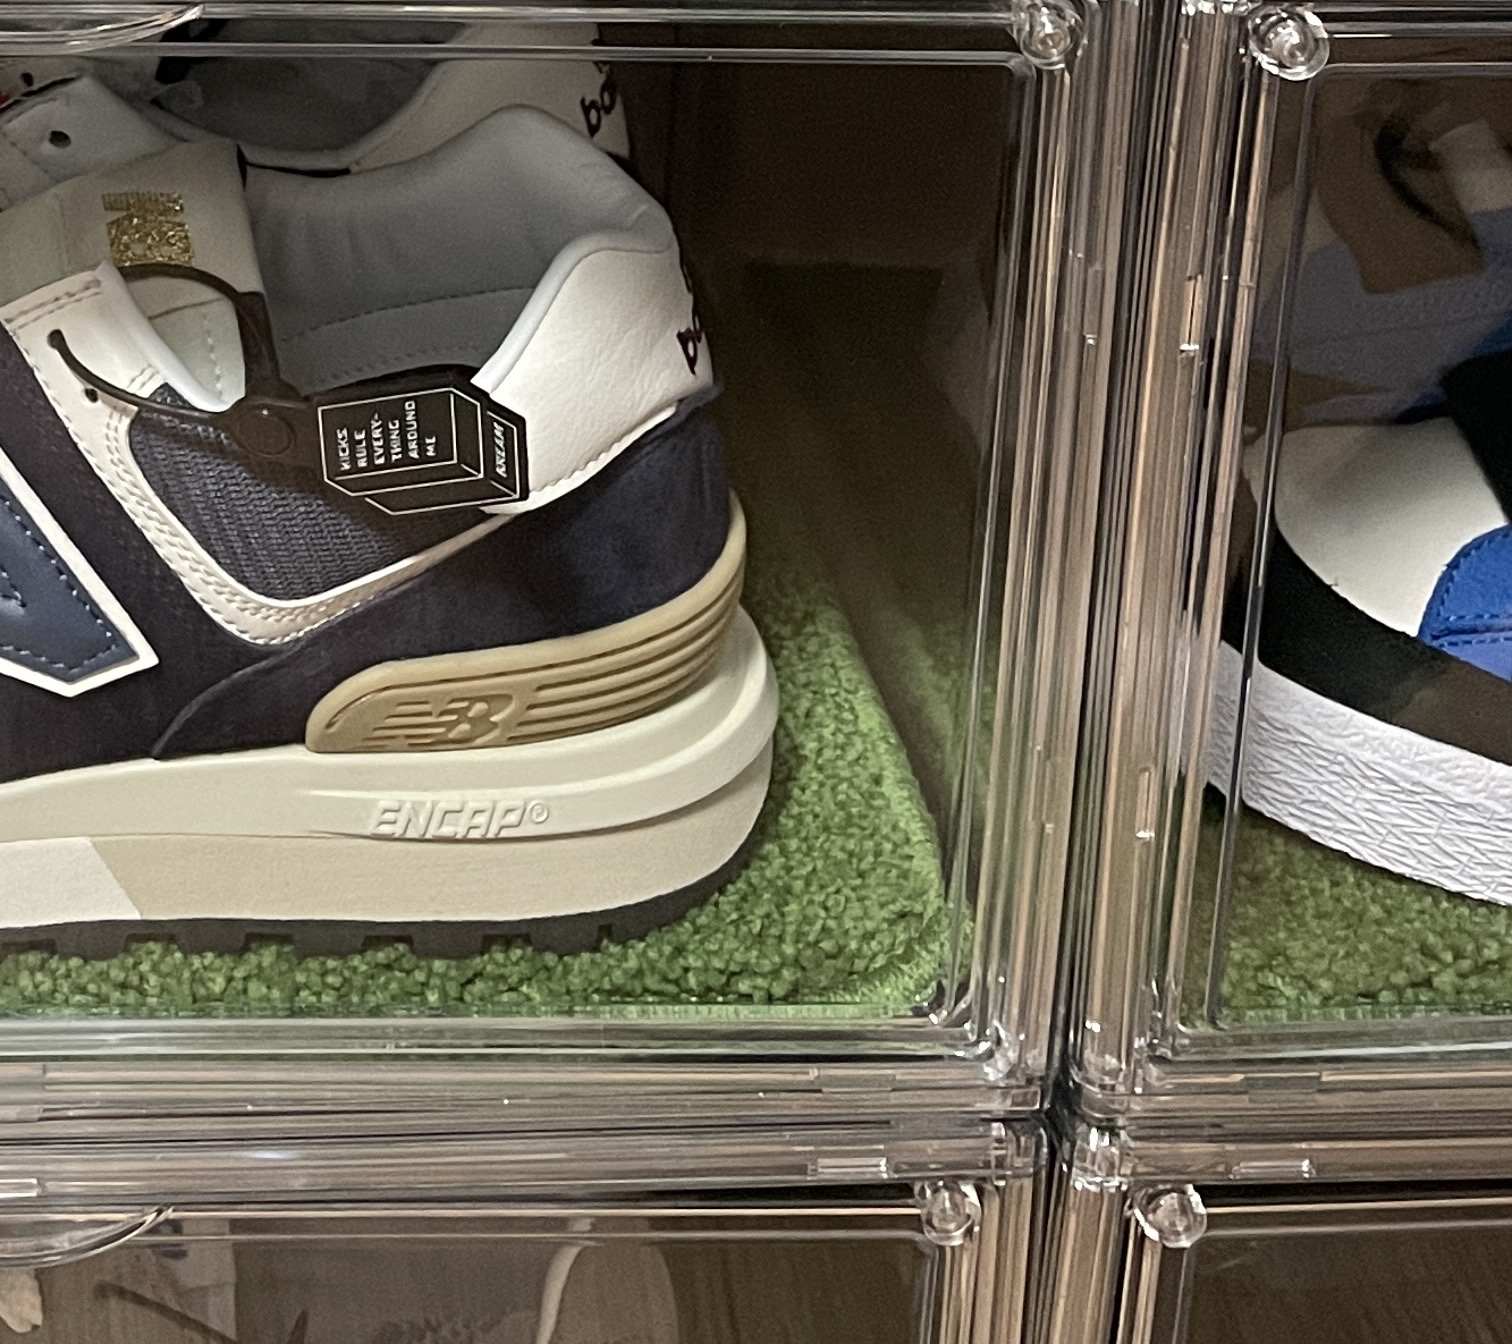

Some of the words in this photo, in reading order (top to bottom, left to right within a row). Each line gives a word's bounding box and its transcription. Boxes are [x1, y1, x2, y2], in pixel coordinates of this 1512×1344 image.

[336, 427, 351, 471] KICKS
[354, 429, 368, 468] RULE
[388, 419, 403, 463] THING
[404, 400, 420, 460] AROUND
[425, 435, 437, 457] ME
